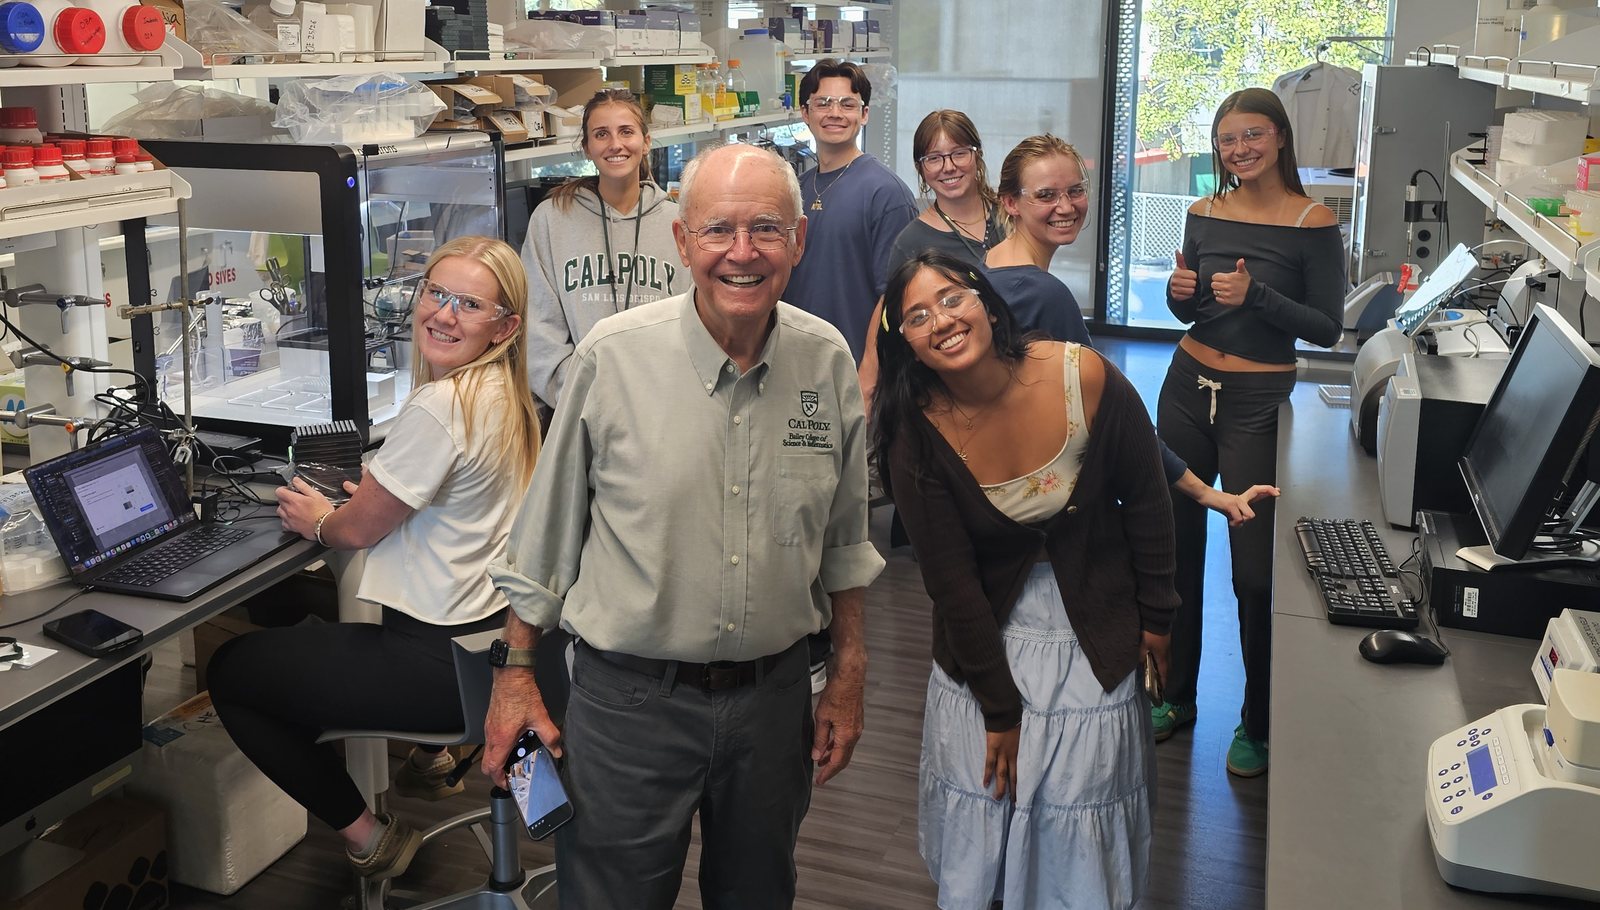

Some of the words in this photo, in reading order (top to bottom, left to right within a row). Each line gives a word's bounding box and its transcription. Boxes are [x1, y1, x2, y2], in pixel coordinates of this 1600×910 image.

[215, 267, 236, 285] SIVES
[564, 252, 612, 293] CAL
[616, 252, 676, 295] POLY
[582, 292, 600, 302] SAN
[788, 418, 807, 429] CAL
[808, 419, 831, 431] POLY
